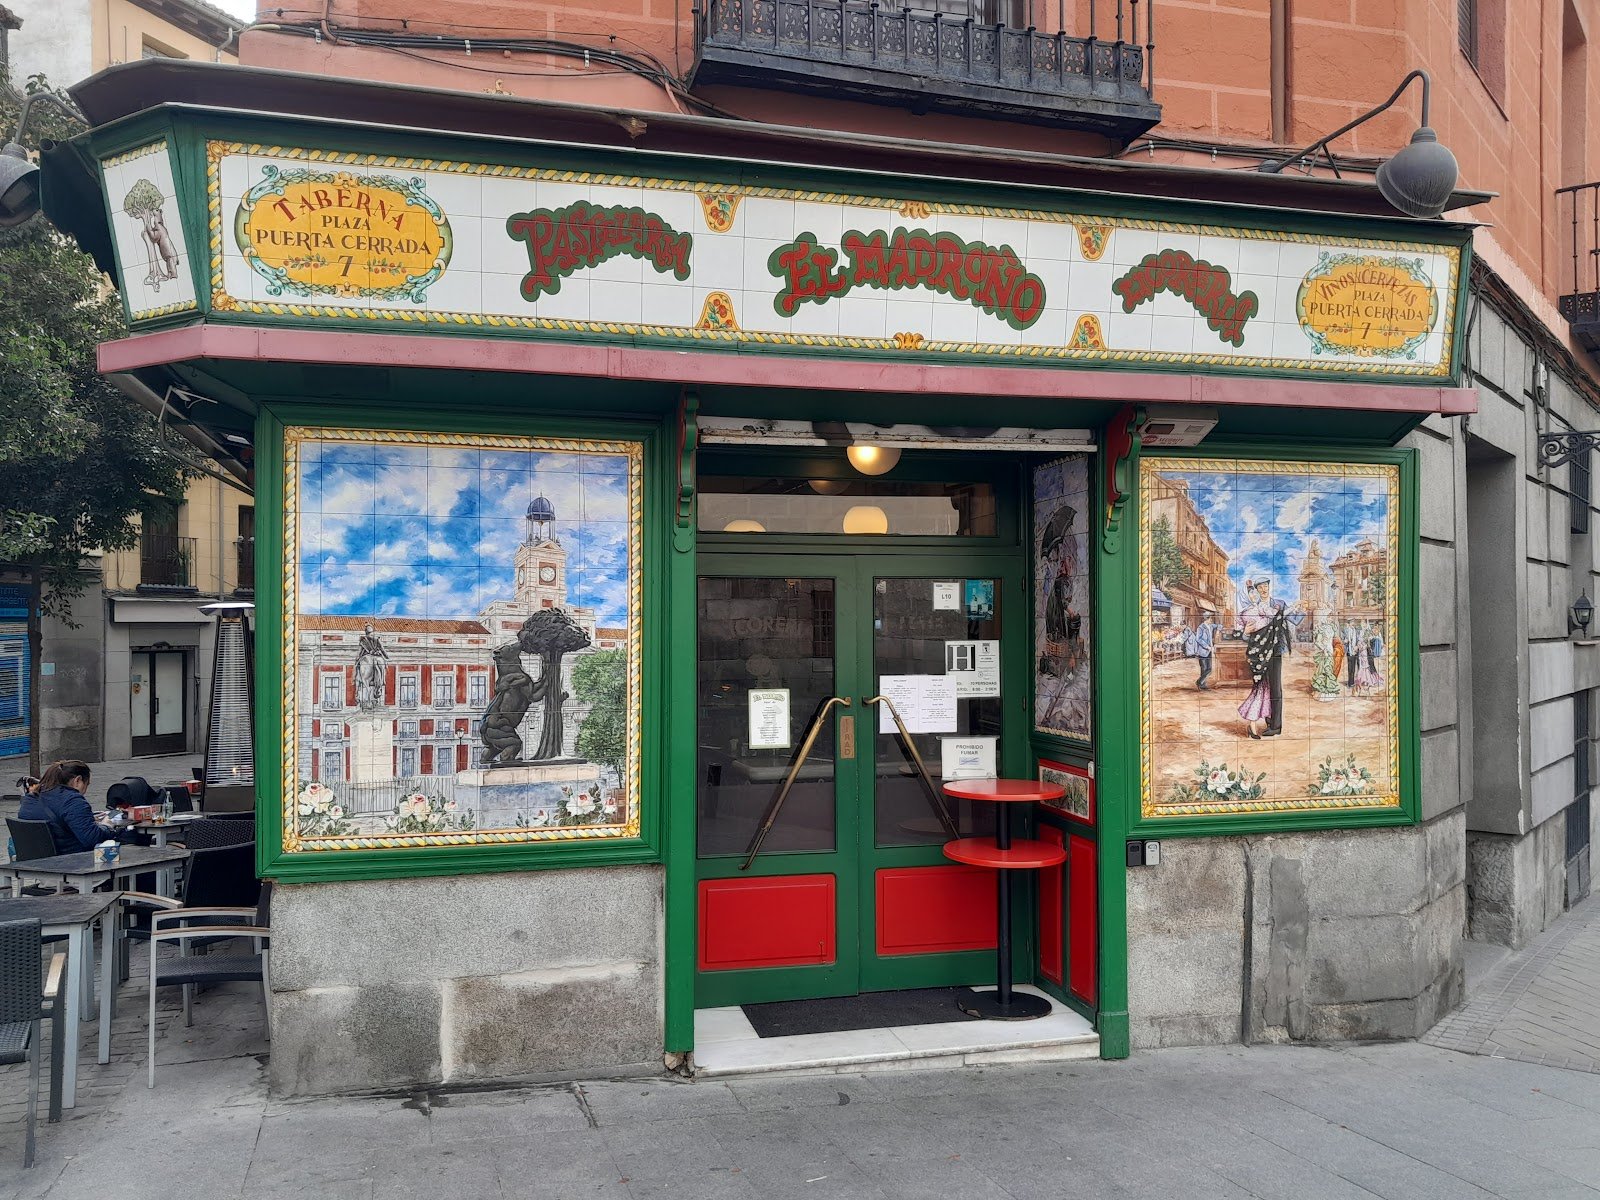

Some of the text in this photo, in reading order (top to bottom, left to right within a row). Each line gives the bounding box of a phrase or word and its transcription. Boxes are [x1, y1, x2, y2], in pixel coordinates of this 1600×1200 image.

[272, 188, 405, 232] TABERNA
[321, 214, 371, 231] PLAZA
[255, 229, 432, 256] PUERTA CERRADA
[338, 254, 354, 278] 7
[774, 232, 1044, 323] EL MADROÑO
[1316, 271, 1355, 302] VINOS
[1361, 268, 1418, 307] CERVEZAS
[1353, 289, 1386, 302] PLAZA
[1309, 302, 1425, 321] PUERTA CERRADA
[1360, 321, 1372, 340] 7
[949, 645, 975, 671] H
